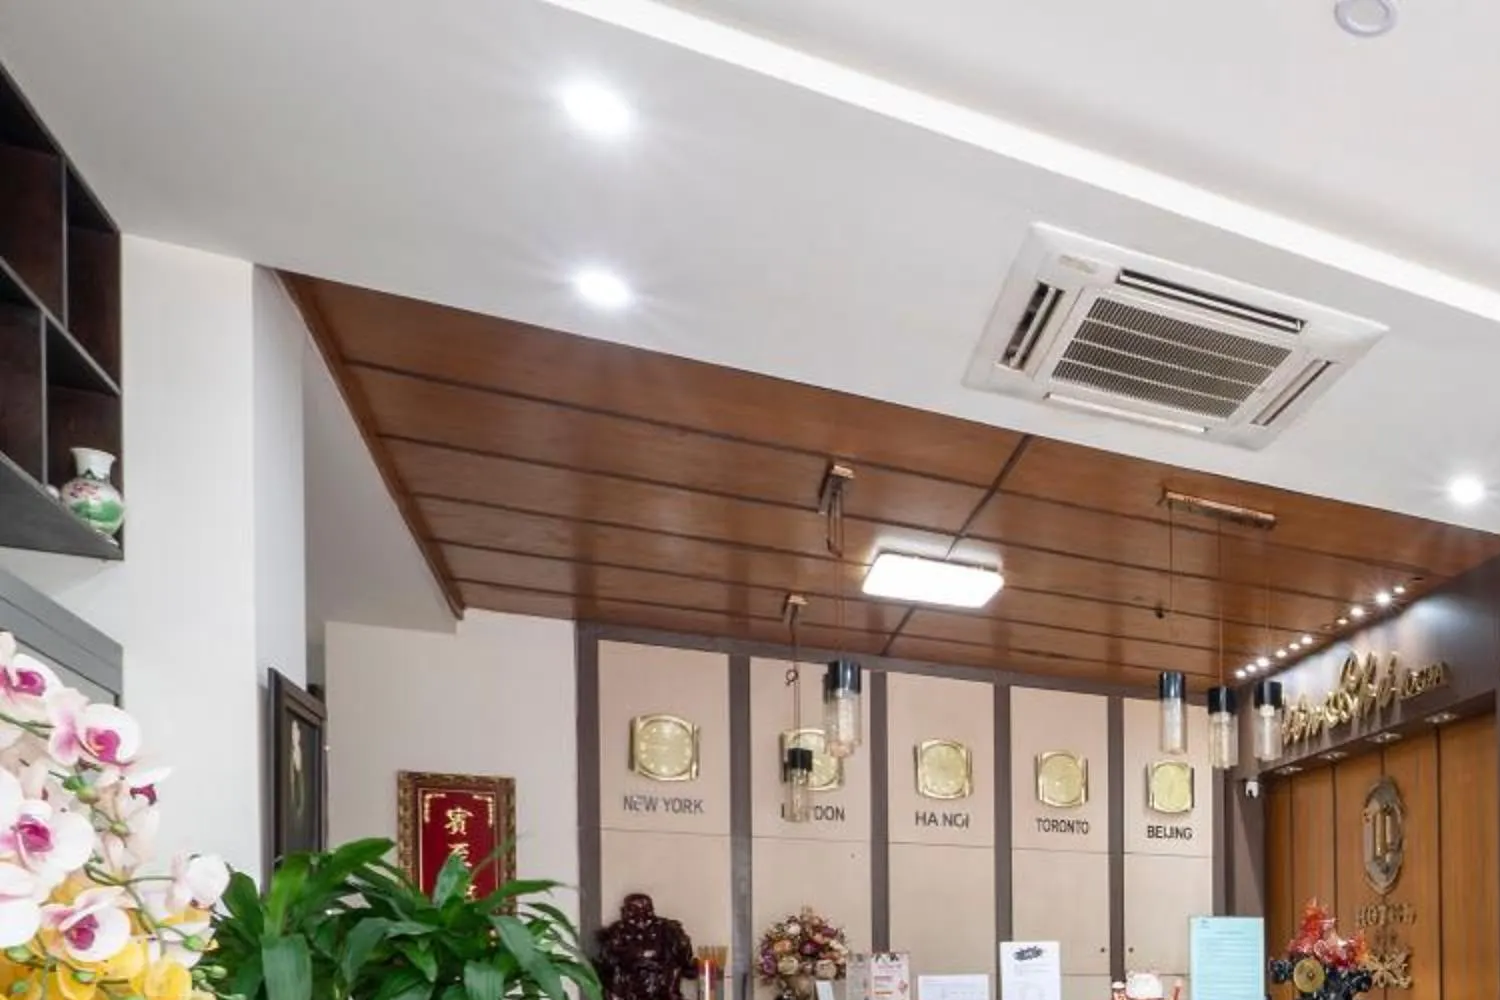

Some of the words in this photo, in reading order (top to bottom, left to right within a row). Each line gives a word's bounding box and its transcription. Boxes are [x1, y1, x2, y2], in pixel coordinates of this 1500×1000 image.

[623, 795, 658, 812] NEW
[662, 797, 705, 815] YORK
[780, 803, 845, 822] LDON
[1036, 817, 1090, 835] TORONTO
[1146, 825, 1193, 840] BEIJING
